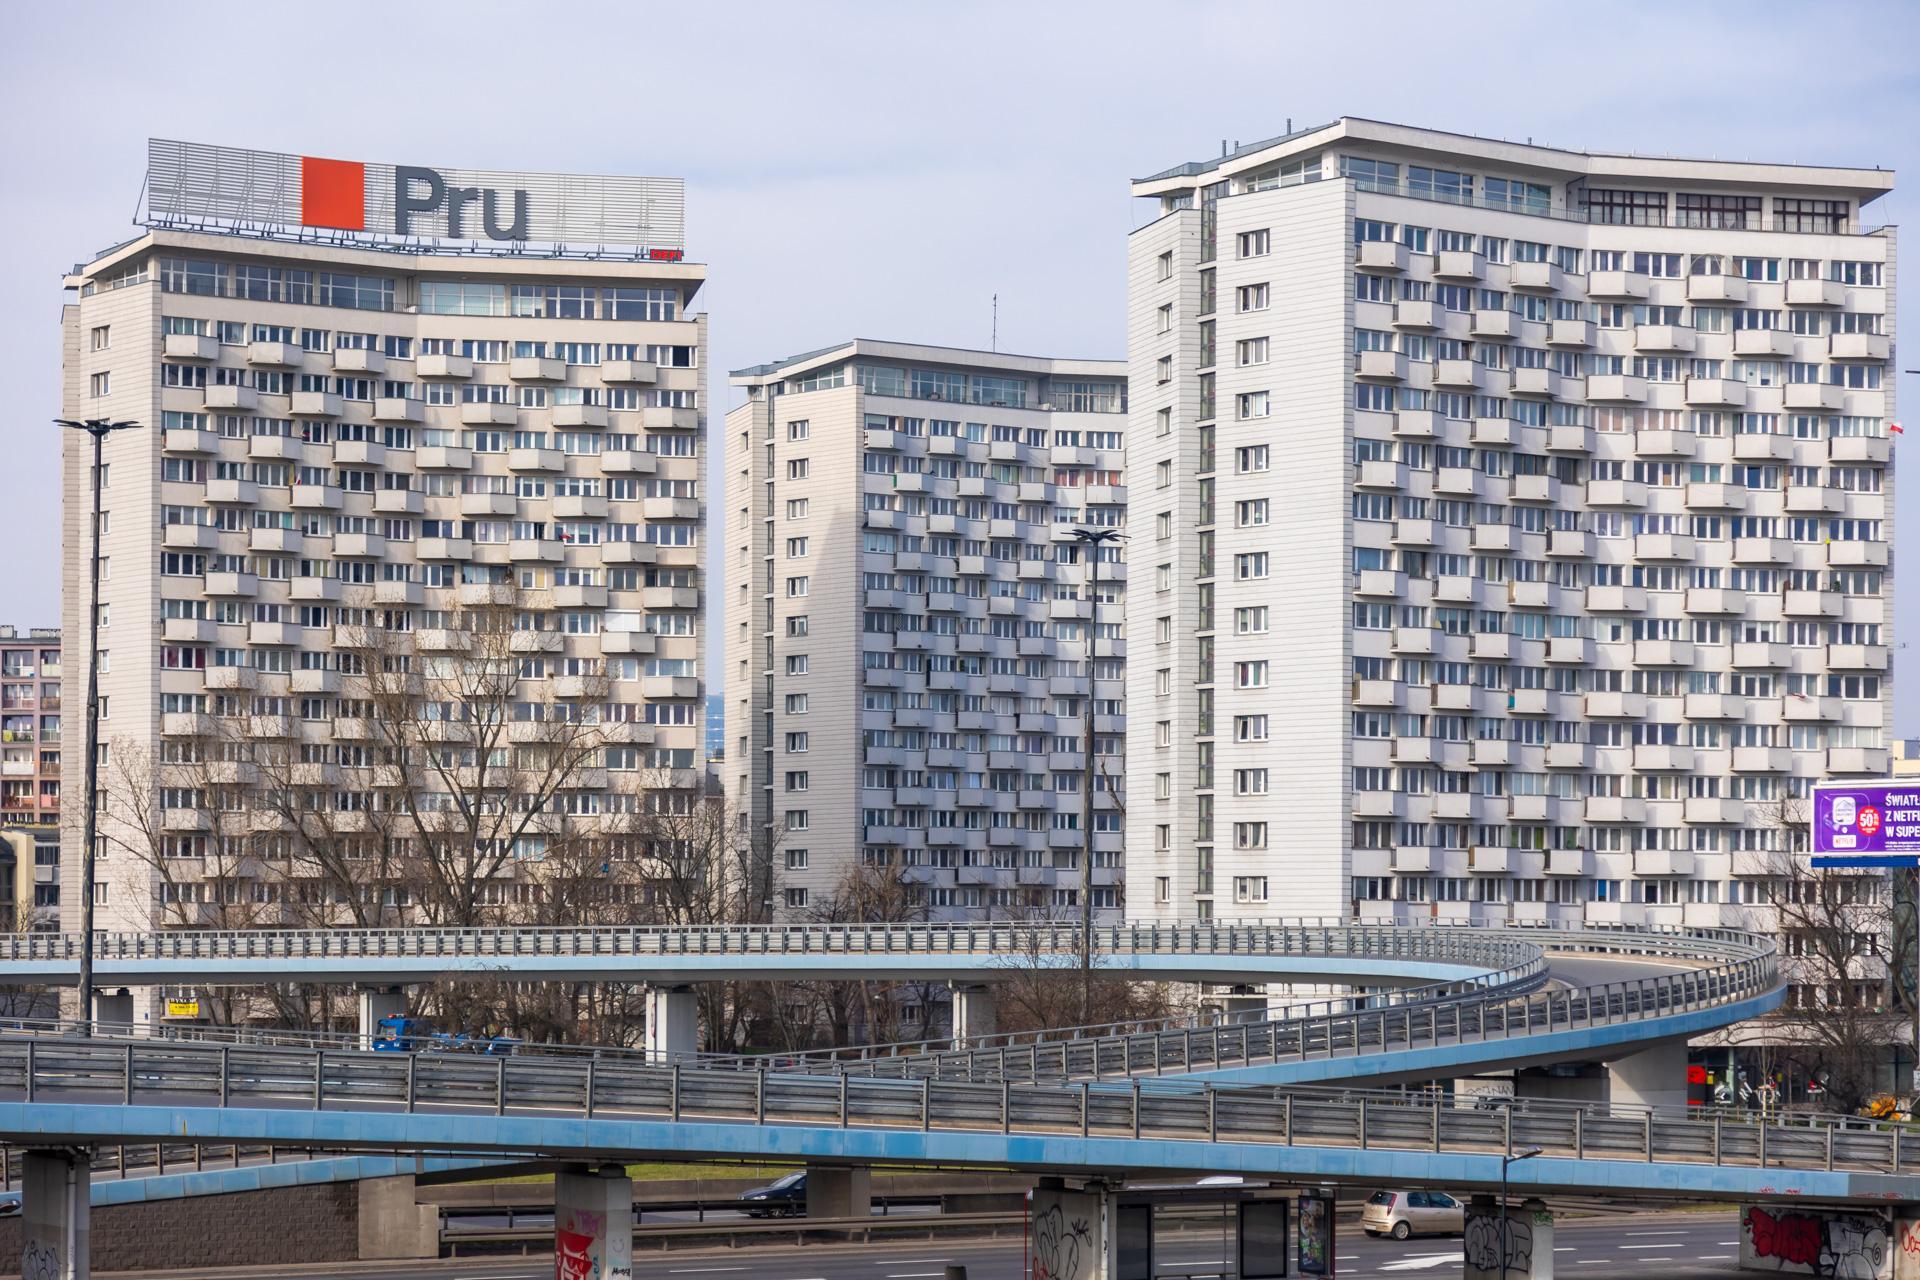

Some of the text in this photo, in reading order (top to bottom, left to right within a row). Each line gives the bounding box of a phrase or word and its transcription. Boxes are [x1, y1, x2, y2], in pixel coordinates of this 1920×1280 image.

[395, 165, 527, 241] Pru
[1860, 813, 1873, 827] 50
[1885, 810, 1892, 822] Z
[1885, 826, 1894, 837] W
